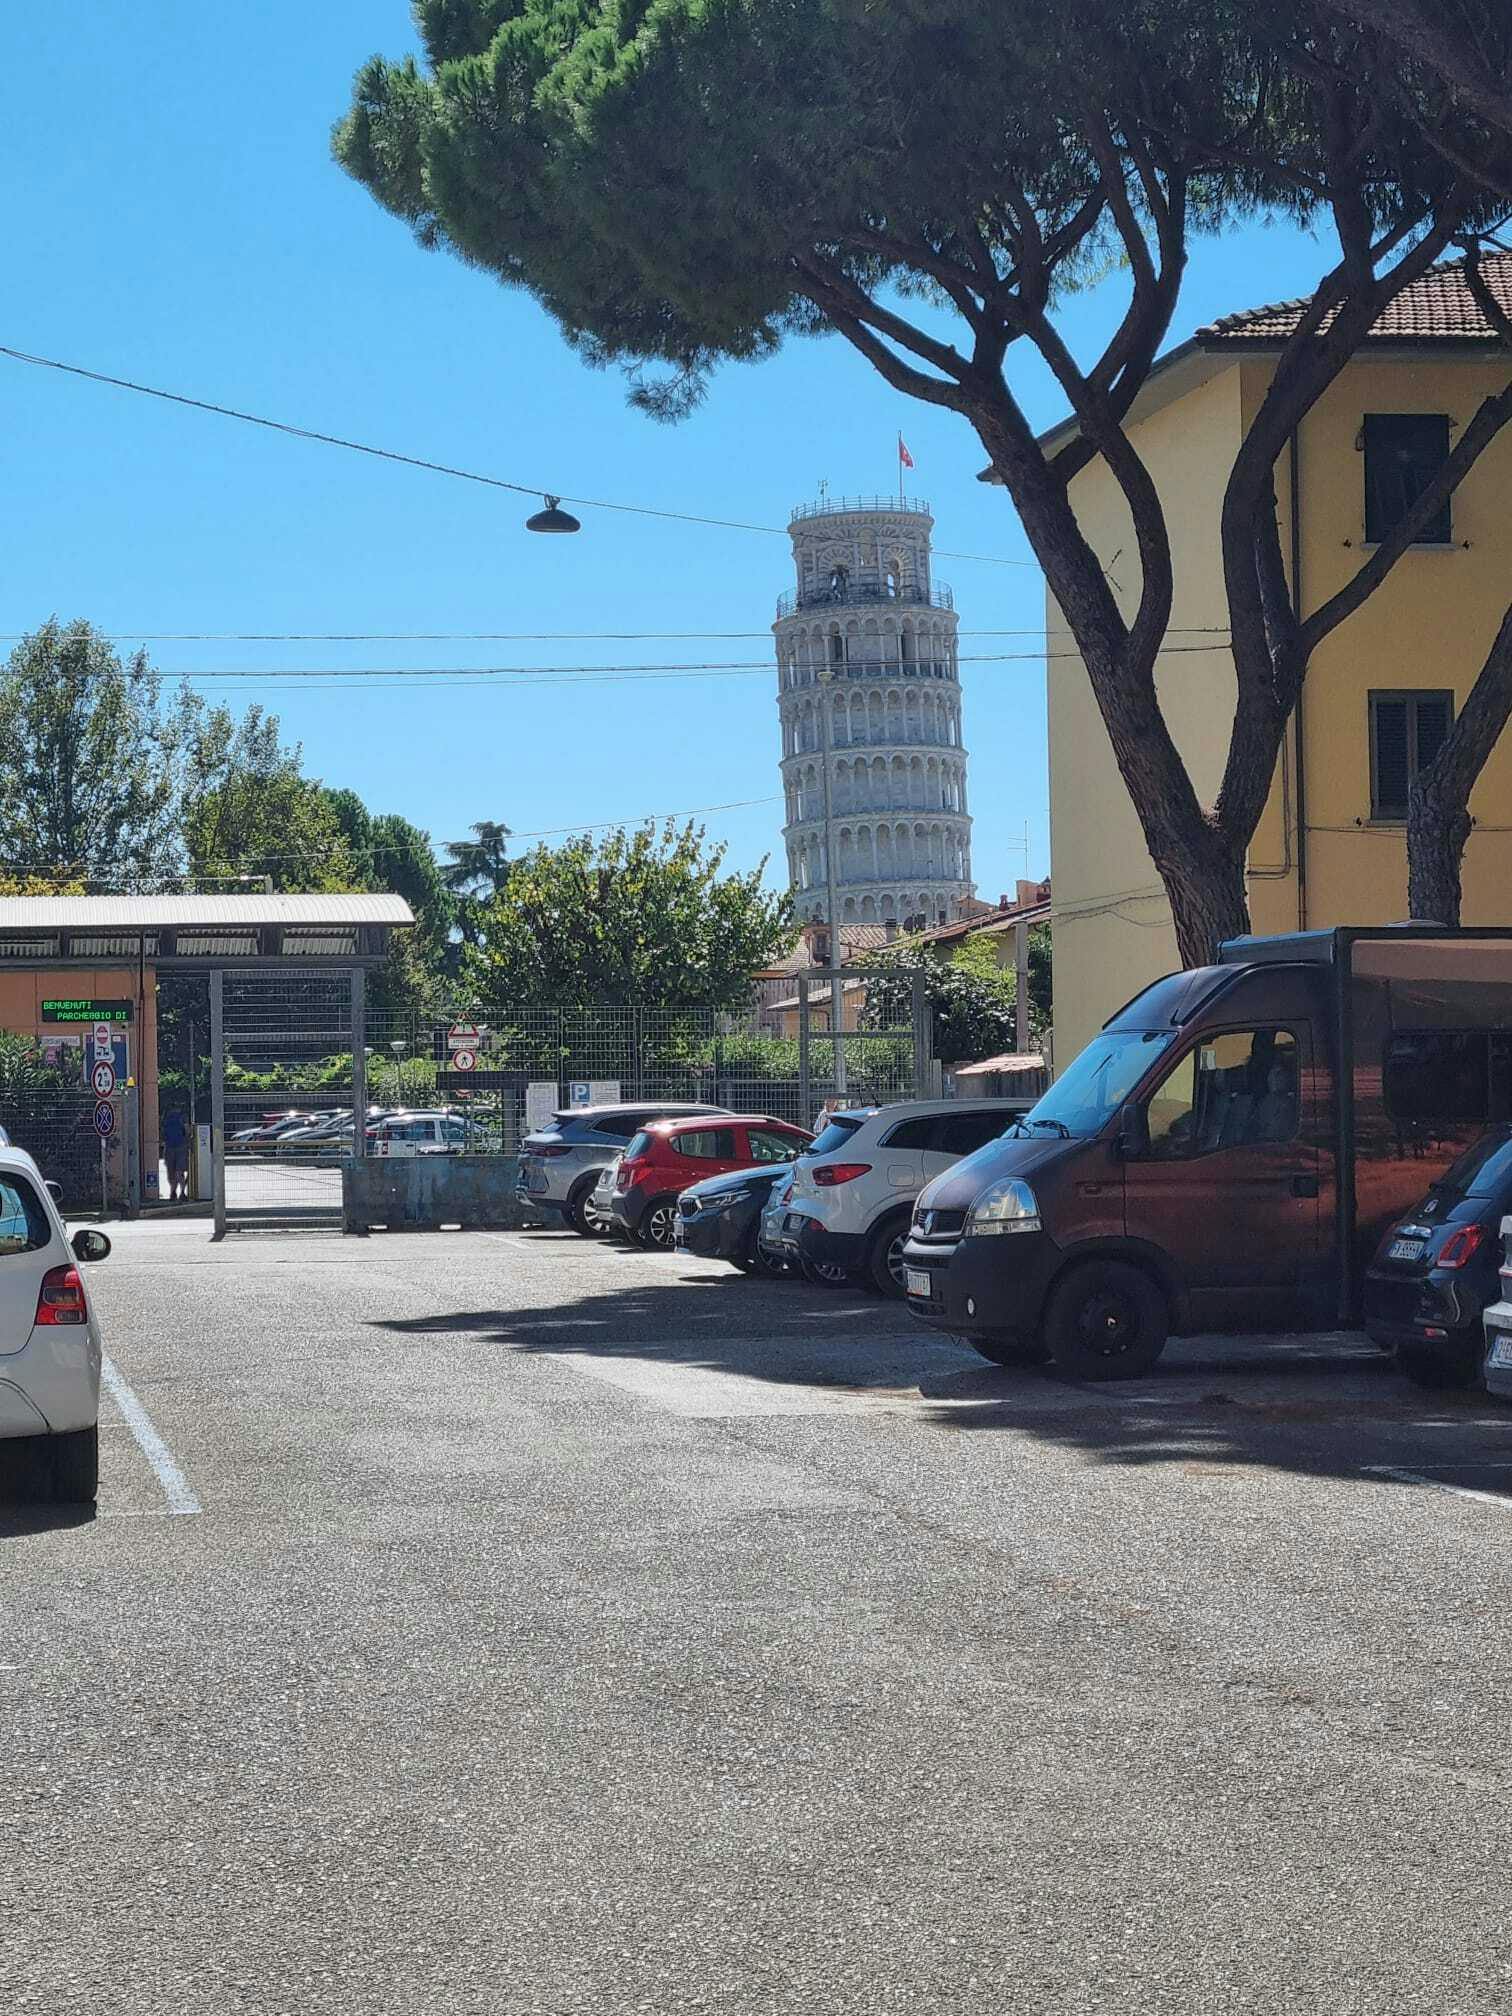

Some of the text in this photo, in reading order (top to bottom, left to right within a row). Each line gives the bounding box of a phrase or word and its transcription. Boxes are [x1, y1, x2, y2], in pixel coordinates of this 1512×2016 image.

[43, 1001, 92, 1010] BENVENUTI
[57, 1011, 127, 1021] PARCHEGGIO DI
[97, 1072, 103, 1087] 2
[575, 1084, 588, 1101] P
